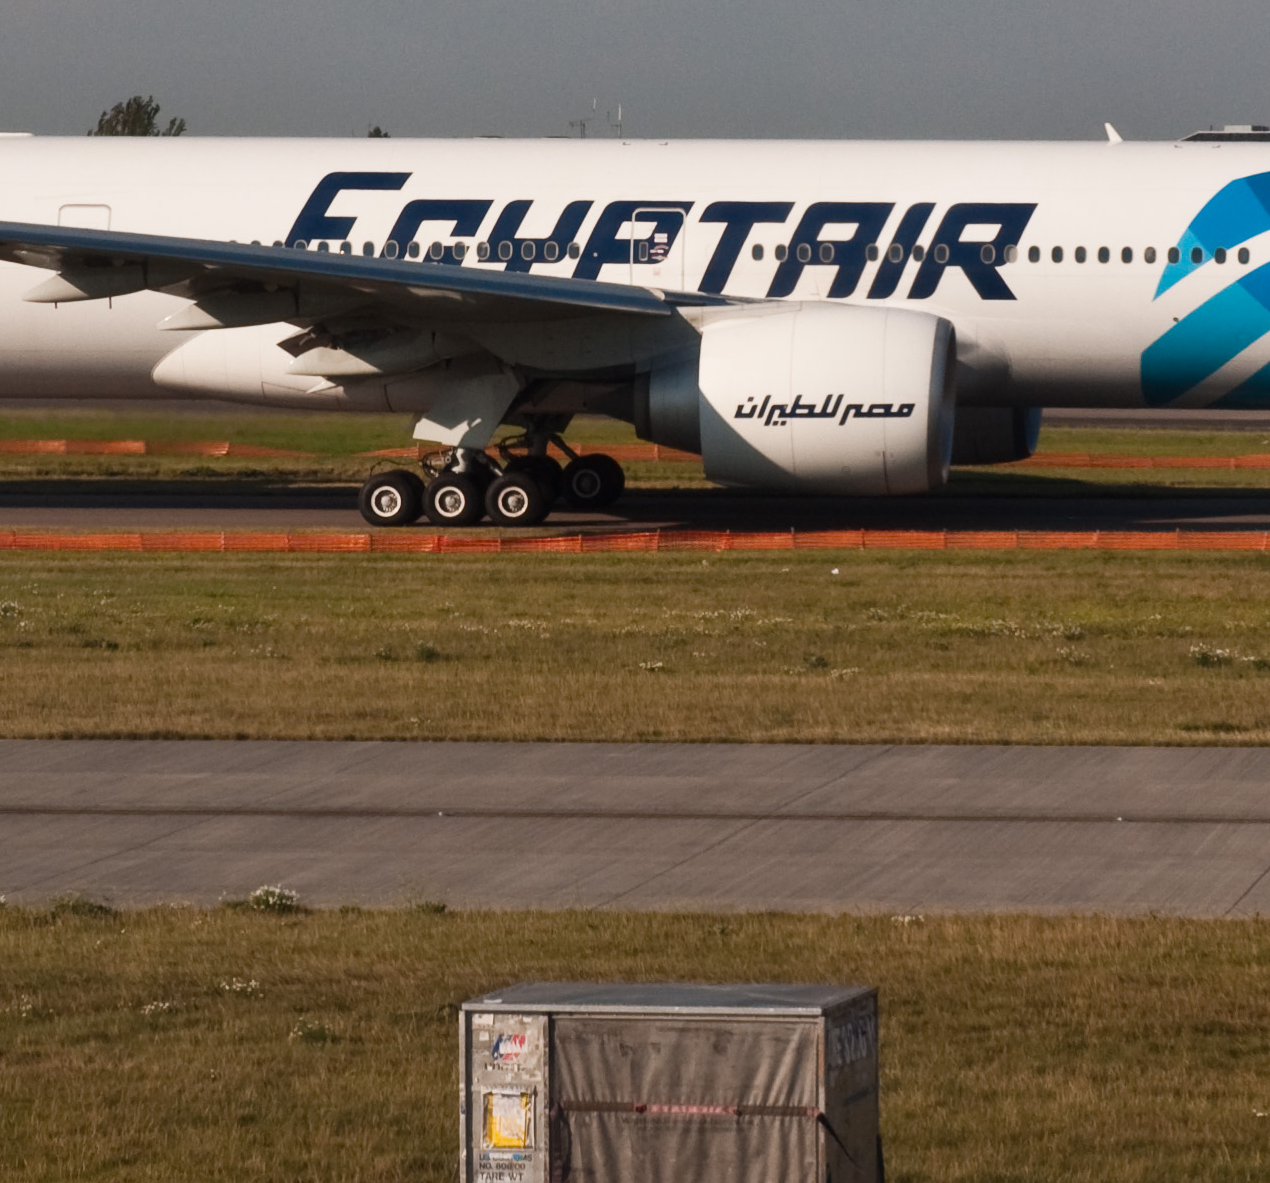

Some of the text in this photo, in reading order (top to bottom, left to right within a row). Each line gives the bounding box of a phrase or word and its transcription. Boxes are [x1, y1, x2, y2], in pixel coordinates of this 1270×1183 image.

[285, 171, 1038, 301] EGYPTAIR
[733, 393, 916, 427] مصر للطيران
